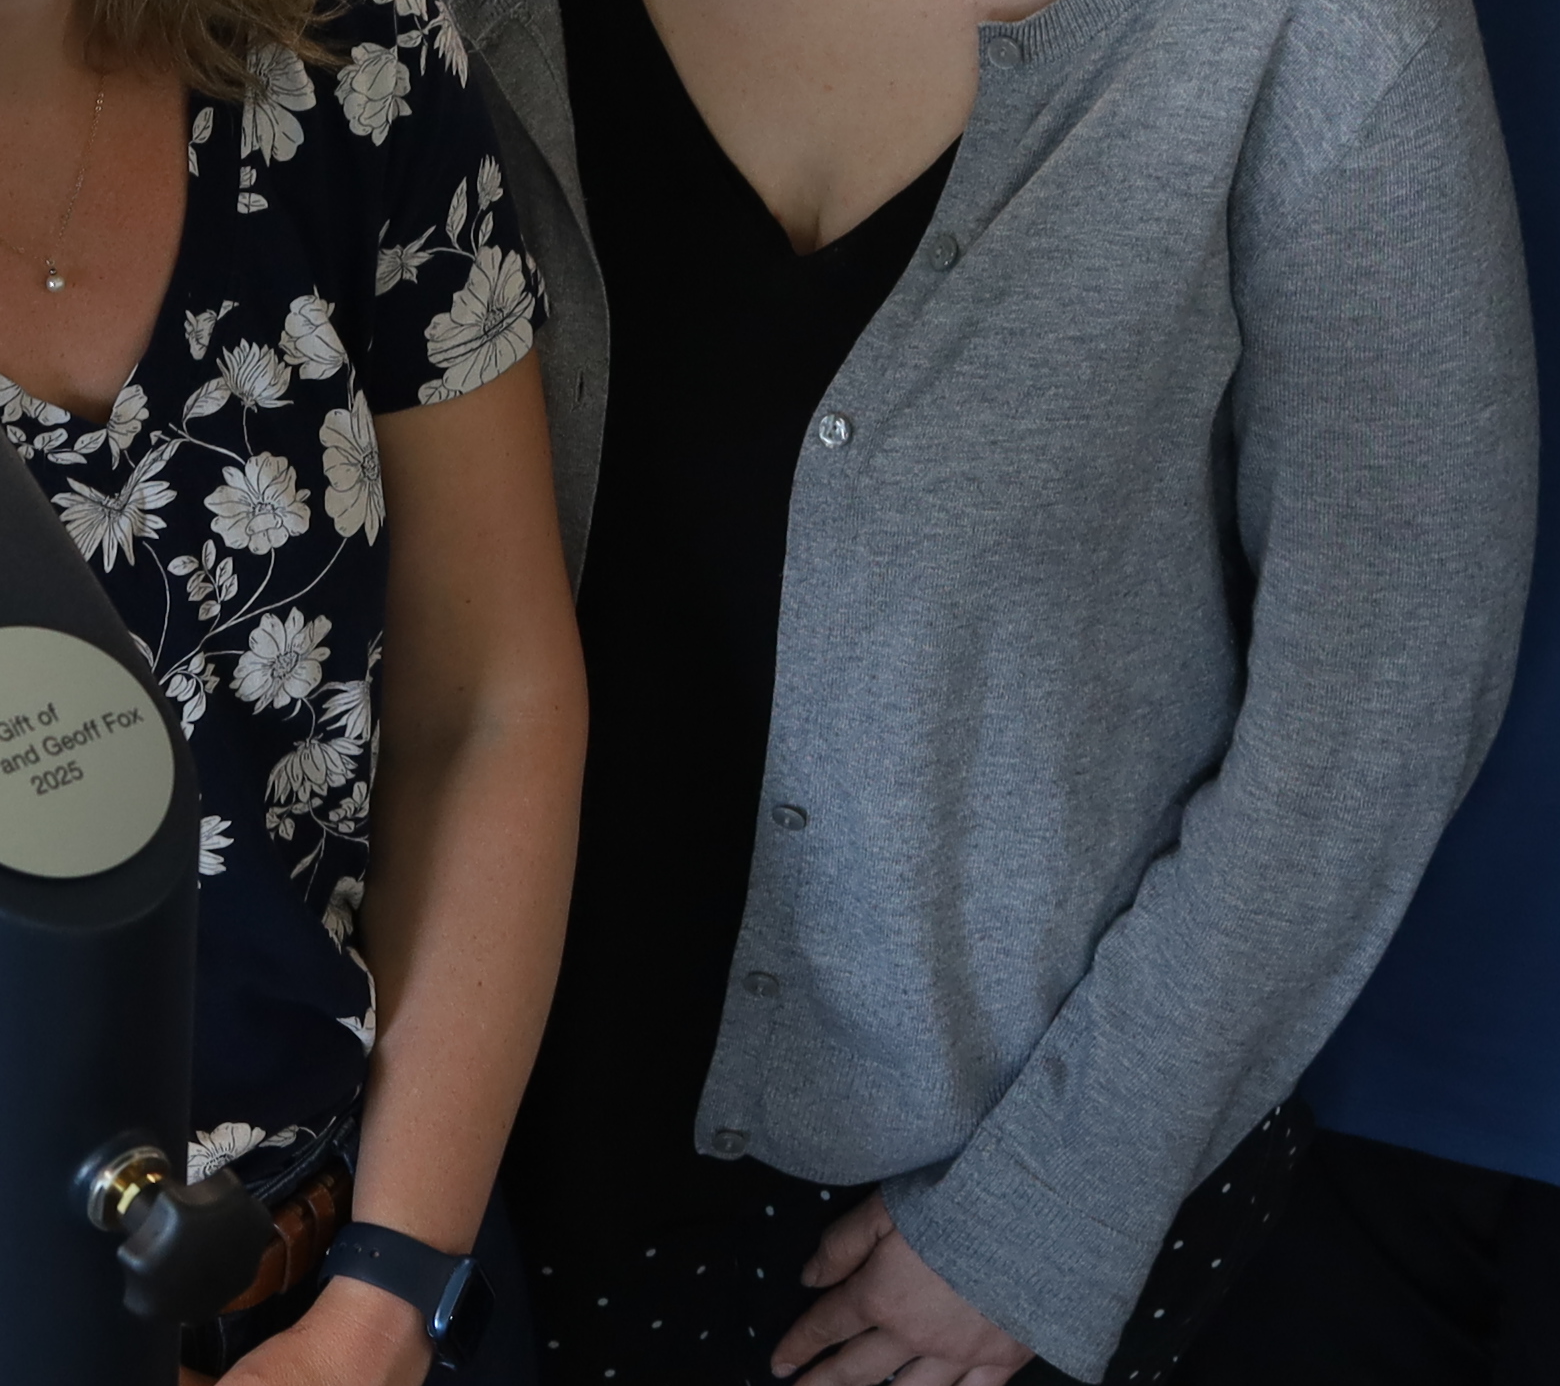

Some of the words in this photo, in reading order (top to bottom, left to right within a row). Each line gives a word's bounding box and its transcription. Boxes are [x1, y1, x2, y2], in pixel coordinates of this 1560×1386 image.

[37, 703, 59, 727] of
[1, 744, 40, 775] and
[42, 719, 102, 756] Geoff
[102, 708, 145, 734] Fox
[30, 761, 84, 796] 2025
